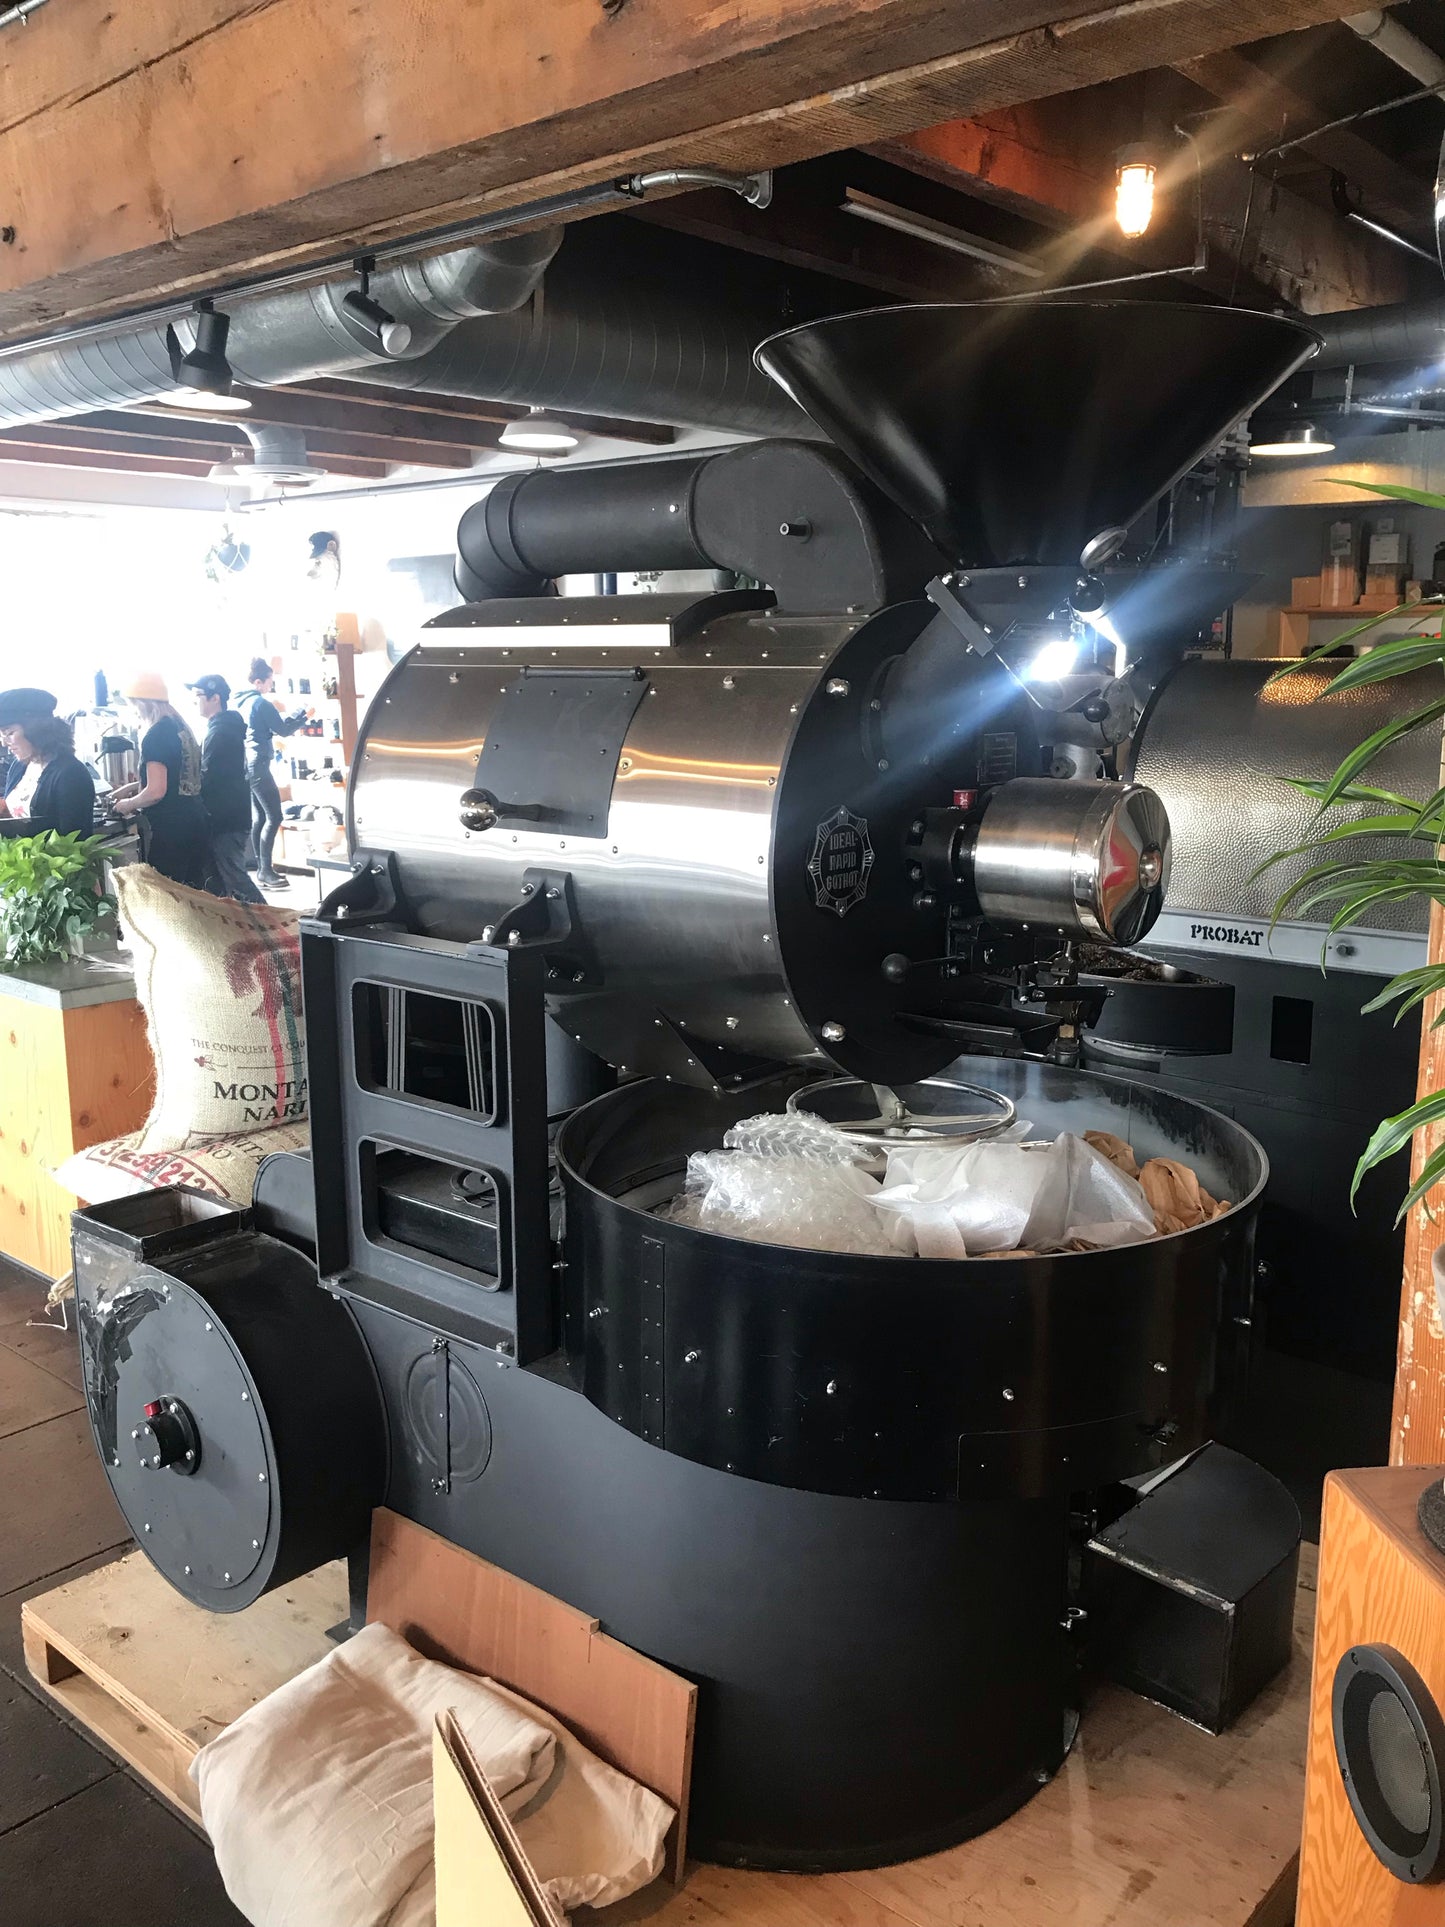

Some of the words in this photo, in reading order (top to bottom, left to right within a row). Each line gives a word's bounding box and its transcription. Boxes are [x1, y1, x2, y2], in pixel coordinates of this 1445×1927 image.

[829, 852, 857, 871] RAPID
[1190, 924, 1264, 946] PROBAT
[191, 1039, 211, 1049] THE
[213, 1042, 268, 1055] CONQUEST
